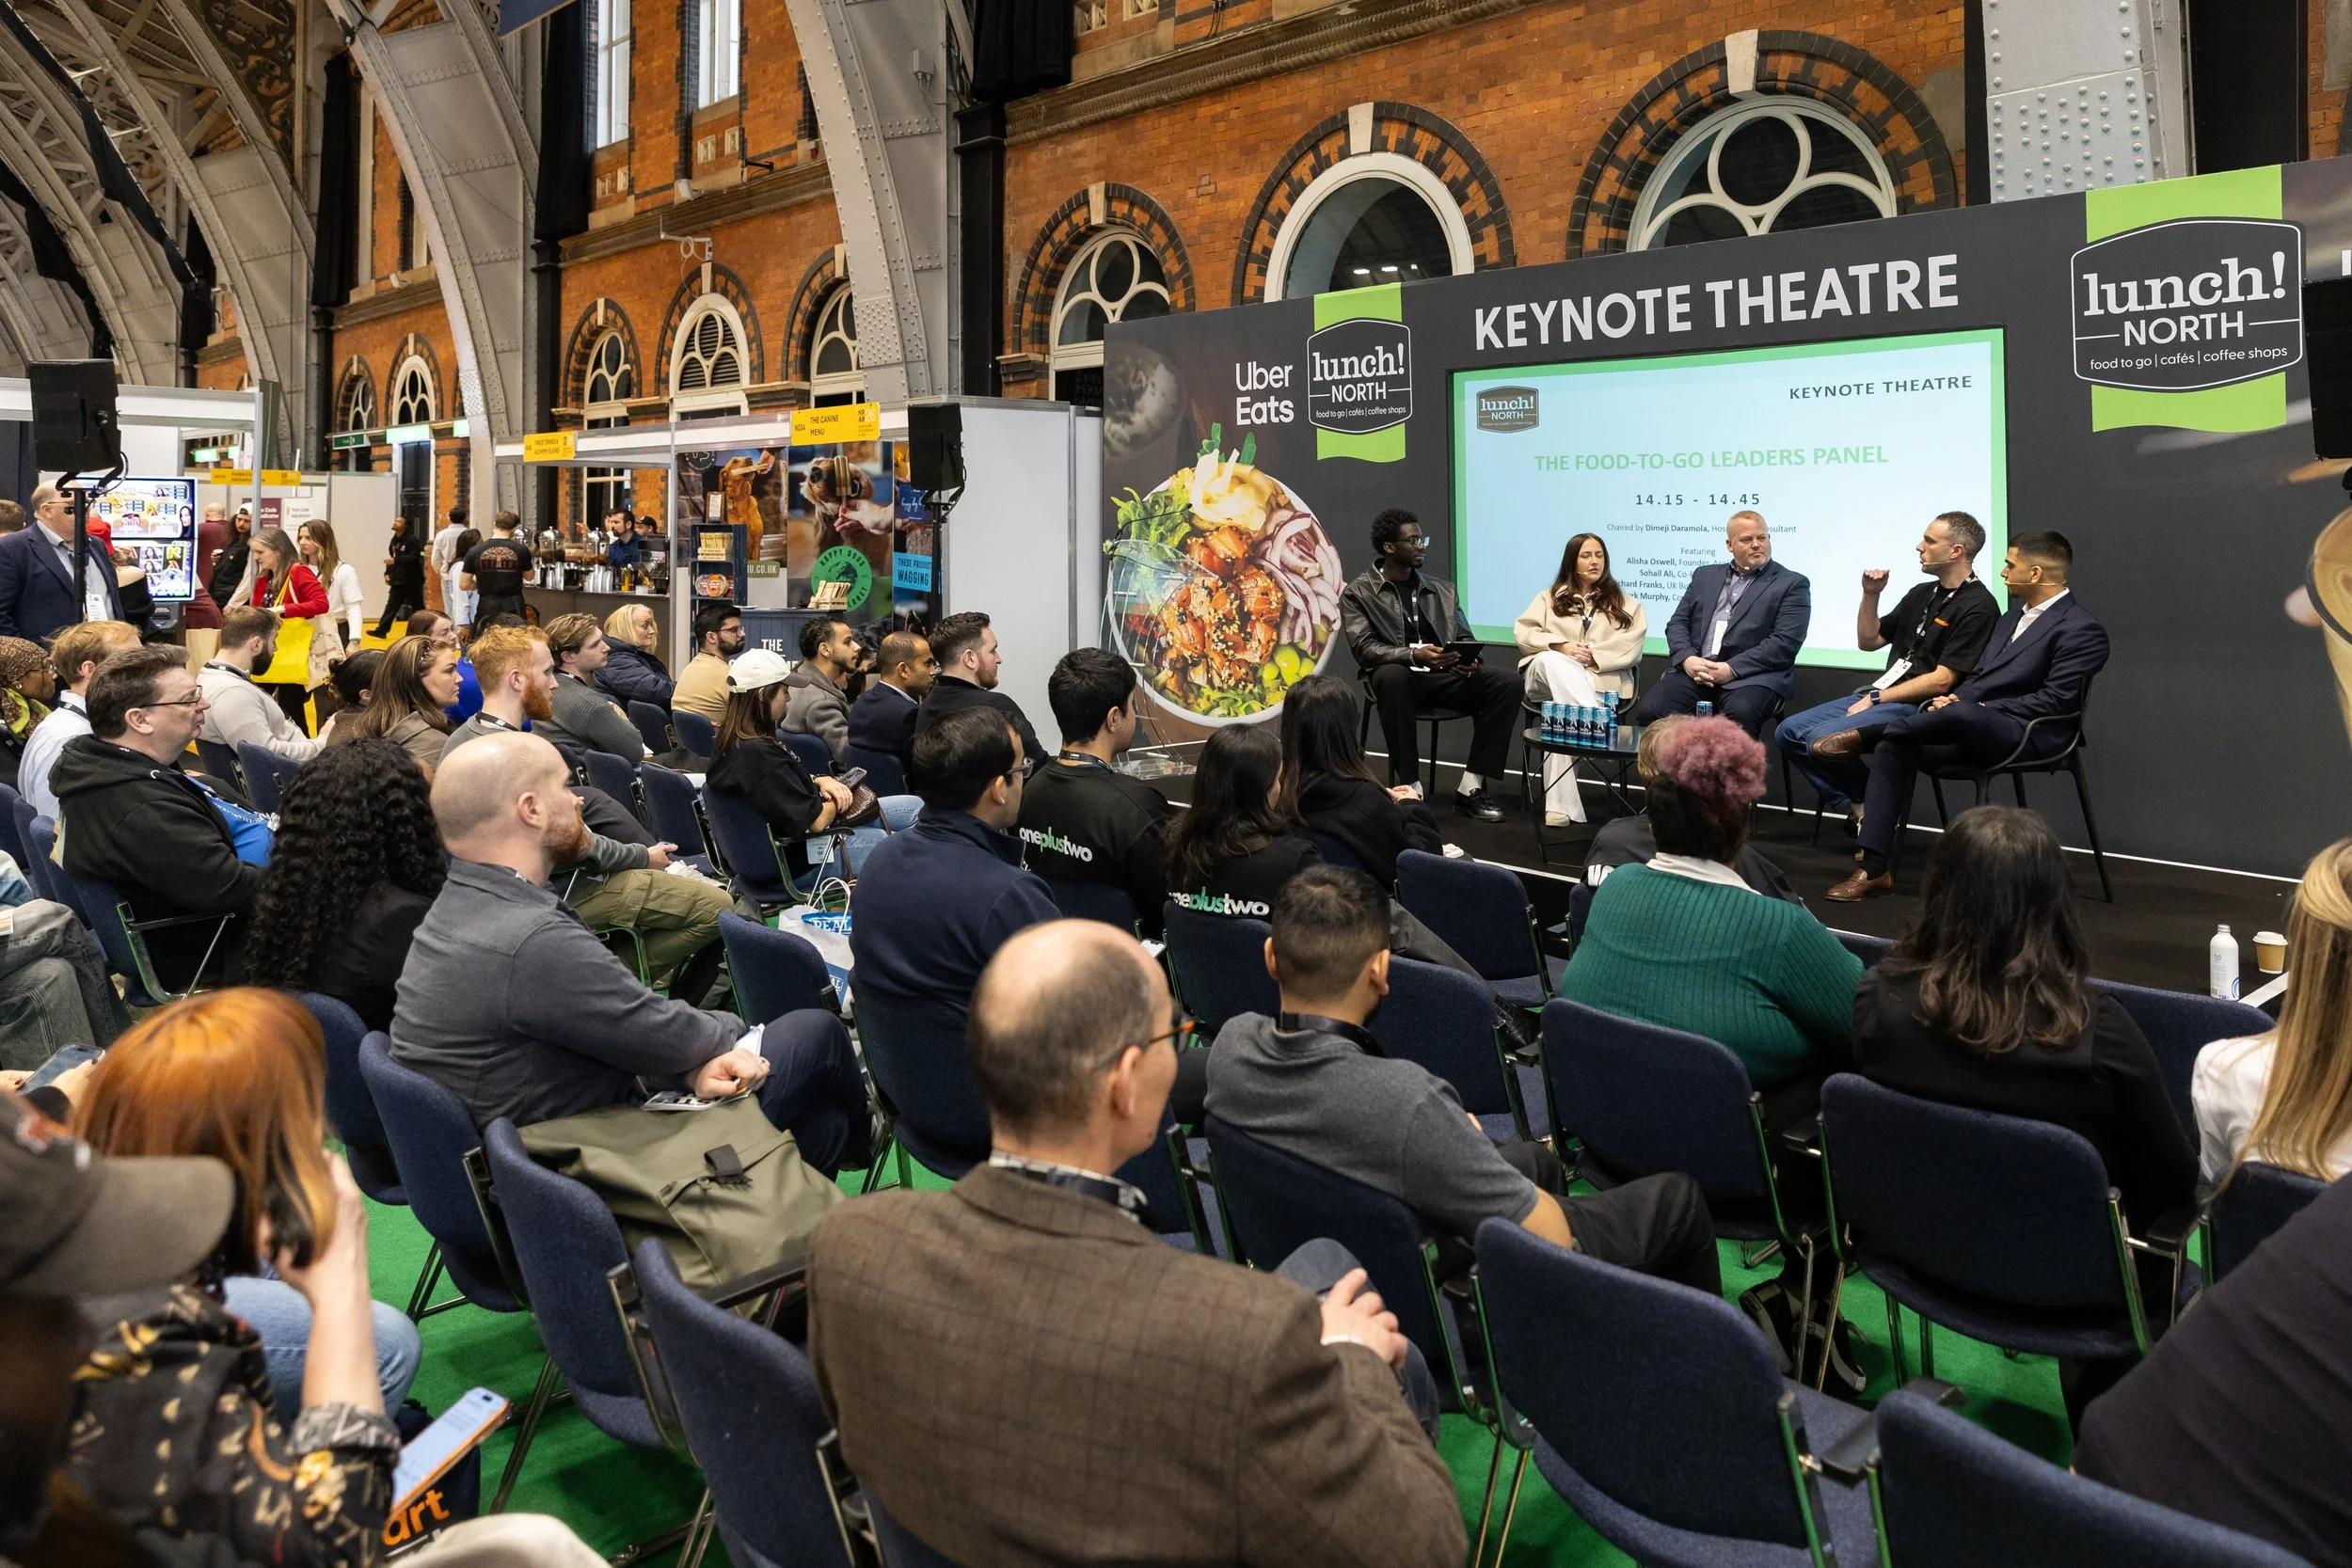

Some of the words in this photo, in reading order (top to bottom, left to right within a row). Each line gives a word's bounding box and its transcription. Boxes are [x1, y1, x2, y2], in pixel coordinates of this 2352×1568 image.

[2082, 251, 2286, 316] lunch!
[1474, 285, 1692, 351] KEYNOTE
[1705, 254, 1958, 328] THEATRE
[2123, 310, 2244, 347] NORTH
[1312, 342, 1405, 382] lunch!
[2090, 357, 2118, 370] food
[2121, 357, 2132, 369] to
[2136, 356, 2153, 370] go
[2160, 353, 2195, 366] cafés
[2203, 348, 2246, 362] coffee
[2248, 346, 2288, 360] shops
[1235, 361, 1293, 391] Uber
[1331, 381, 1387, 403] NORTH
[1789, 382, 1875, 400] KEYNOTE
[1883, 375, 1972, 393] THEATRE
[1236, 395, 1295, 426] Eats
[1480, 395, 1534, 411] lunch!
[1316, 410, 1329, 419] food
[1348, 407, 1364, 417] cafés
[1367, 406, 1387, 415] coffee
[1388, 406, 1406, 415] shops
[1491, 411, 1524, 420] NORTH
[1534, 454, 1569, 471] THE
[1575, 451, 1704, 470] FOOD-TO-GO
[1711, 448, 1806, 467] LEADERS
[1813, 445, 1888, 466] PANEL
[1635, 494, 1683, 505] 14.15
[1708, 494, 1760, 505] 14.45
[1607, 523, 1633, 531] Chaired
[1635, 524, 1644, 533] by
[1645, 524, 1669, 533] Dimeji
[1671, 524, 1710, 533] Daramola,
[1768, 524, 1797, 533] sultant
[819, 548, 842, 566] HAPPY
[1680, 547, 1716, 558] Featuring
[898, 557, 912, 567] THESE
[1627, 557, 1648, 565] Alisha
[1649, 558, 1677, 566] Oswell,
[898, 569, 930, 586] WAGGING
[1639, 569, 1661, 578] Sohail
[1663, 569, 1676, 578] Ali,
[1617, 579, 1637, 588] chard
[1639, 580, 1664, 590] Franks,
[1640, 593, 1671, 602] Murphy,
[761, 639, 783, 652] THE
[1019, 826, 1093, 863] oneplustwo
[1168, 886, 1270, 916] neplustwo
